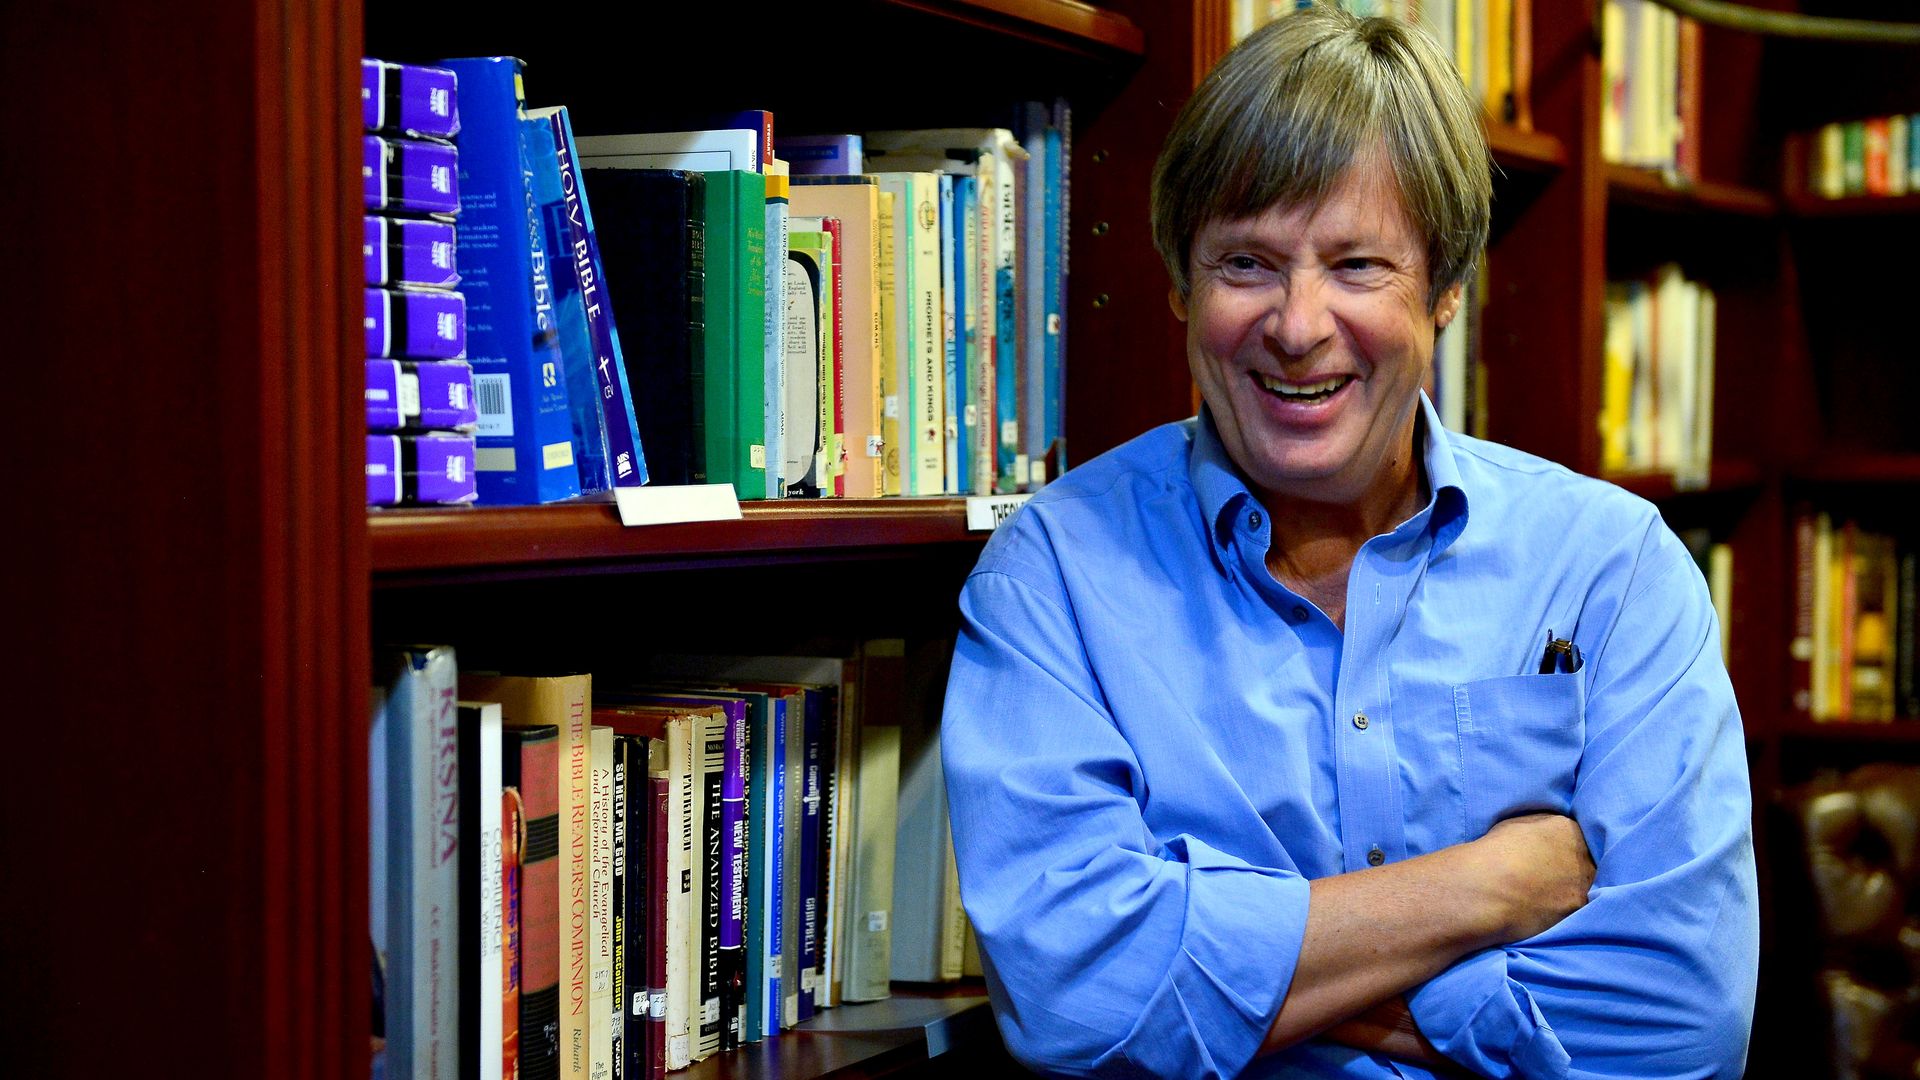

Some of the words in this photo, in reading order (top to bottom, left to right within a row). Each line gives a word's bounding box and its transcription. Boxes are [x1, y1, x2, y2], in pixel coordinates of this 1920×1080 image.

[557, 147, 583, 228] HOLY
[575, 239, 600, 323] BIBLE
[617, 451, 630, 466] ABS
[788, 488, 804, 496] york
[570, 702, 584, 741] THE
[571, 743, 584, 800] BIBLE
[601, 768, 609, 779] A
[615, 763, 624, 781] SO
[745, 785, 751, 795] IS
[599, 784, 609, 838] History
[615, 784, 624, 818] HELP
[711, 780, 721, 820] THE
[744, 798, 750, 815] MY
[591, 798, 600, 863] Reformed
[600, 840, 609, 856] of
[615, 821, 624, 847] ME
[733, 820, 743, 849] NEW
[571, 803, 585, 905] READER'S
[600, 855, 609, 876] the
[614, 848, 624, 877] GOD
[592, 868, 600, 919] Church
[709, 827, 721, 929] ANALYZED
[731, 851, 743, 921] TESTAMENT
[481, 910, 490, 957] Wilson
[599, 881, 609, 958] Evangelical
[804, 897, 816, 955] CAMPBELL
[570, 906, 585, 1017] COMPANION
[613, 944, 622, 1010] McCollister
[707, 935, 719, 993] BIBLE
[572, 1027, 582, 1074] Richards
[595, 1061, 604, 1069] The
[613, 1040, 621, 1078] WJKP
[592, 1069, 608, 1080] Pilgrim
